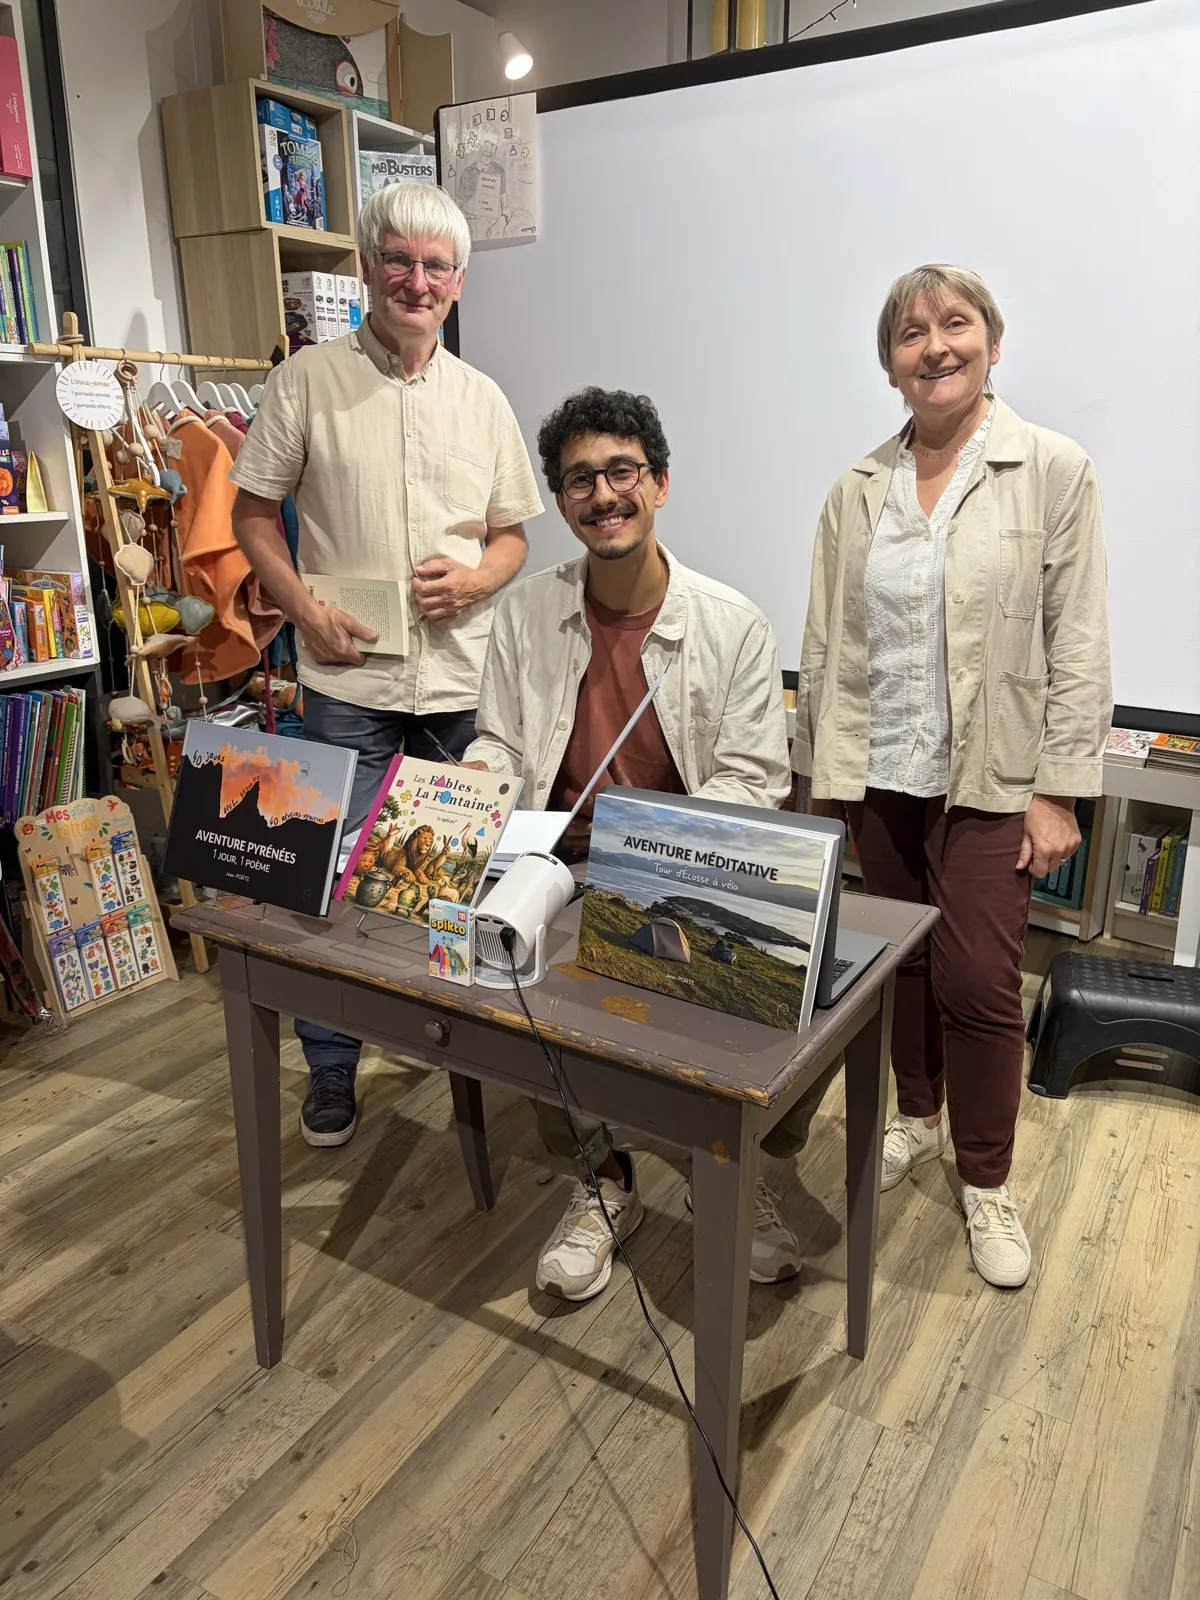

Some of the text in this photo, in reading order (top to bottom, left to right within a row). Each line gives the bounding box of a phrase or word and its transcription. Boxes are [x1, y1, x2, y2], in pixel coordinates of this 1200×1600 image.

[193, 750, 202, 765] 40
[414, 774, 426, 783] Les
[429, 775, 472, 792] Fables
[415, 788, 430, 799] La
[433, 790, 492, 812] Fontaine
[45, 809, 70, 824] Mes
[195, 830, 296, 864] AVENTURE PYRÉNÉES
[213, 848, 271, 873] 1 JOUR, 1 POÈME
[624, 836, 778, 881] AVENTURE MÉDITATIVE
[236, 874, 250, 882] PORTE
[654, 863, 739, 890] Tour d'Écosse à vélo
[431, 918, 466, 936] spikto
[678, 976, 694, 985] PORTE
